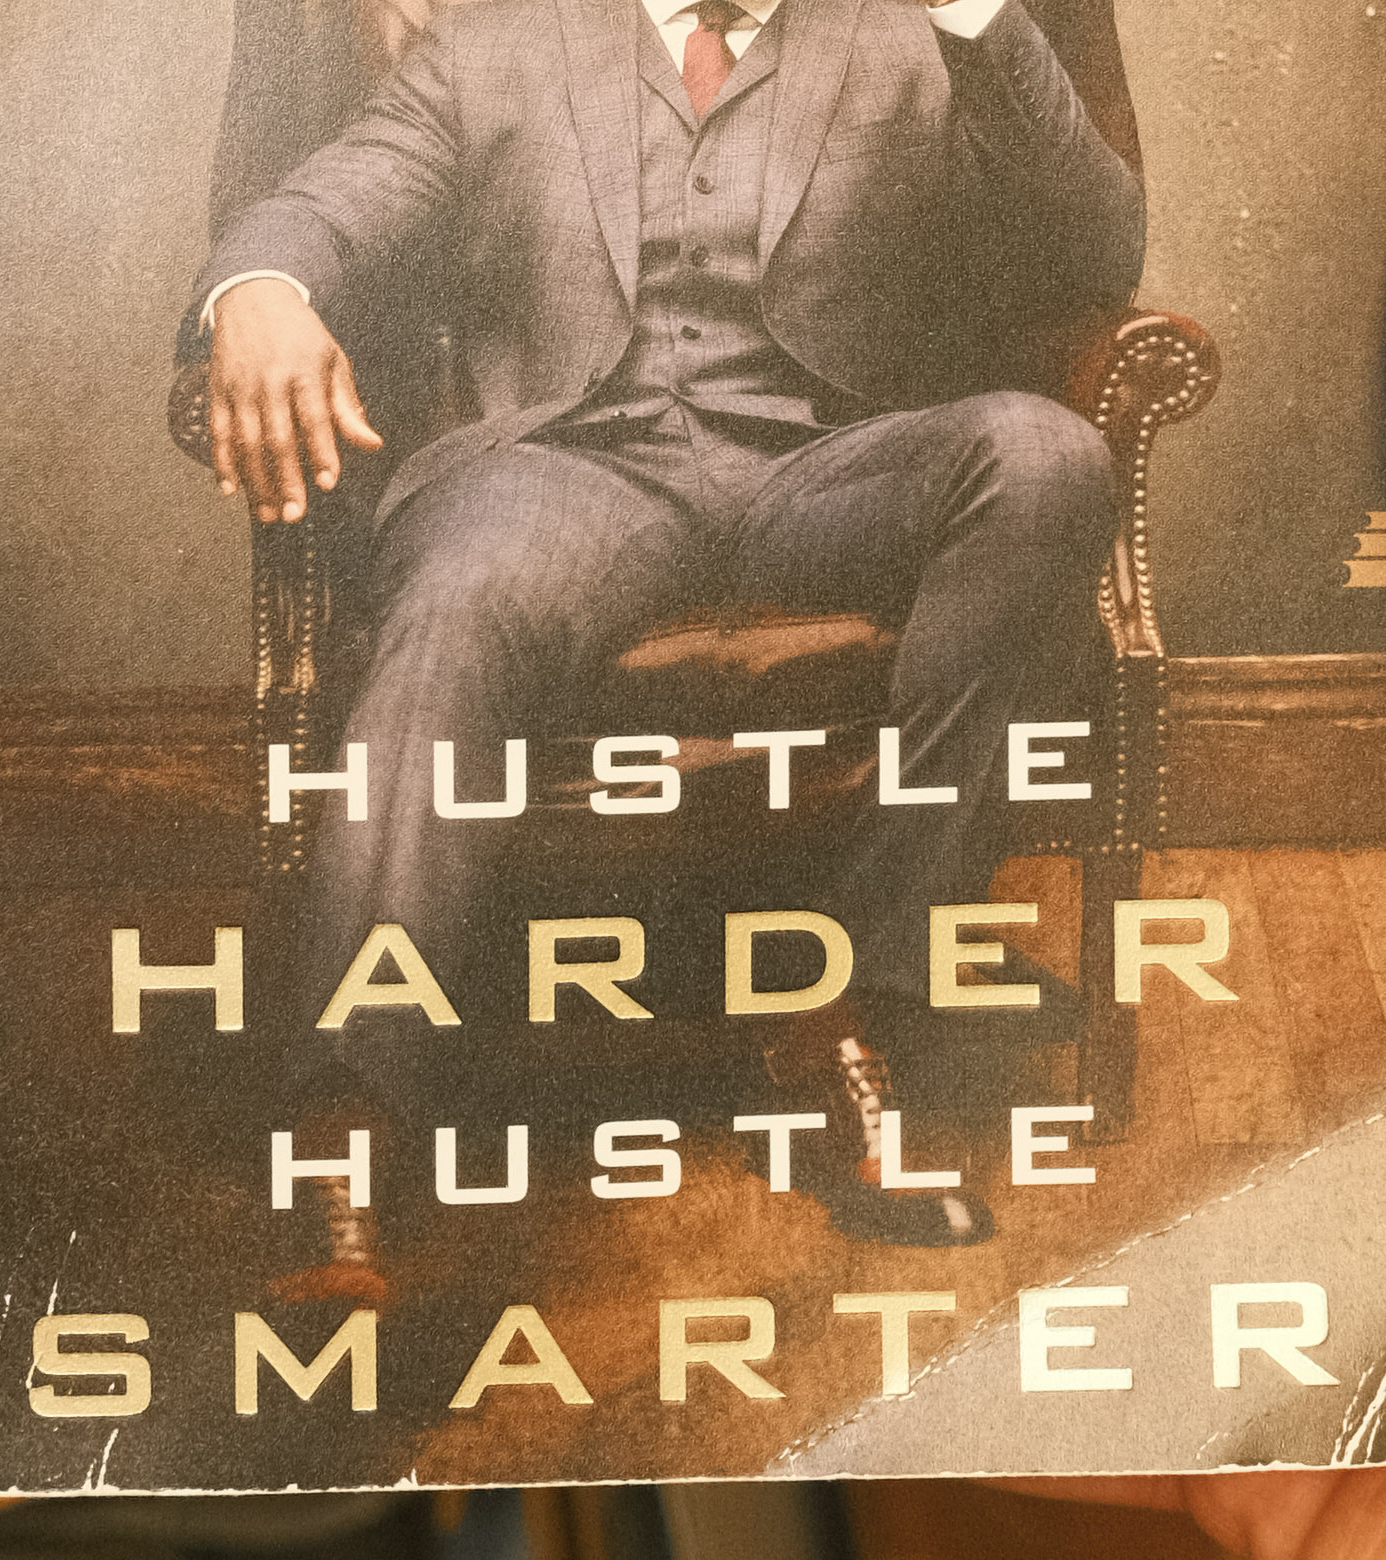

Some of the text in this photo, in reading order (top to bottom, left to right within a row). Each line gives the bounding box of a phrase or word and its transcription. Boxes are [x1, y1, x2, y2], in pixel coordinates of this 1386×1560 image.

[268, 721, 1093, 823] HUSTLE
[110, 898, 1240, 1035] HARDER
[270, 1105, 1097, 1210] HUSTLE
[26, 1279, 1342, 1417] SMARTER
